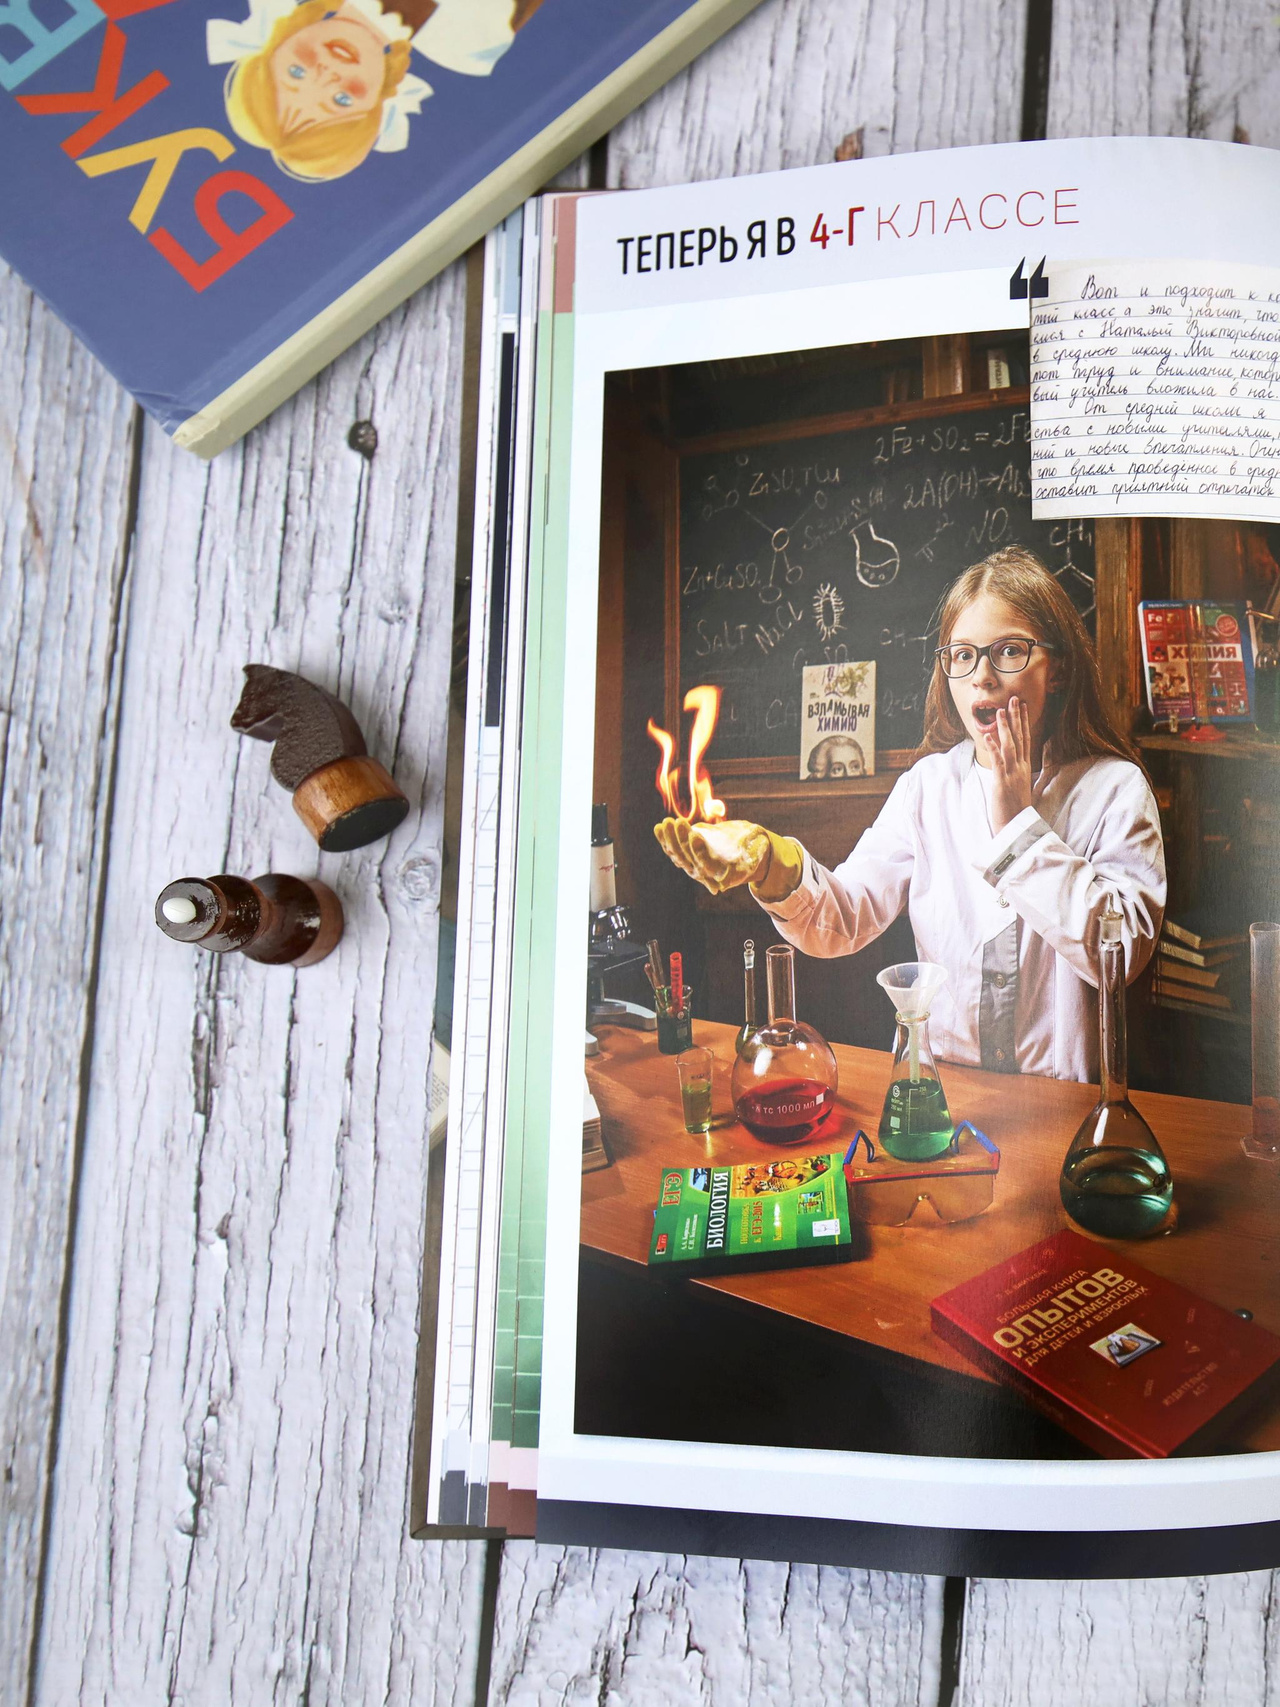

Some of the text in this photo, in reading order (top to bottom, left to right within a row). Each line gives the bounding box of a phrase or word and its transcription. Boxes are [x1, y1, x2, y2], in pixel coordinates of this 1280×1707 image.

[0, 0, 295, 294] БУКВ
[616, 188, 1080, 275] ТЕПЕРЬ Я В 4-Г КЛАССЕ
[1081, 274, 1118, 299] Вот
[1140, 286, 1149, 296] и
[1164, 284, 1236, 308] подходит
[1249, 290, 1259, 300] к
[1124, 307, 1132, 316] а
[1148, 304, 1172, 316] это
[1256, 310, 1279, 323] что
[1078, 329, 1085, 338] с
[1033, 348, 1040, 363] в
[1053, 346, 1118, 370] среднюю
[1184, 338, 1215, 357] Мы
[1073, 365, 1115, 388] труд
[1130, 366, 1141, 376] и
[1070, 383, 1129, 408] учитель
[1147, 378, 1217, 397] вложила
[1230, 381, 1238, 396] в
[1248, 388, 1279, 399] нас.
[1085, 396, 1107, 415] От
[1192, 404, 1242, 417] школы
[1253, 407, 1267, 419] я
[1034, 425, 1071, 439] ства
[1087, 425, 1094, 435] с
[1107, 419, 1167, 435] новыми
[1064, 447, 1076, 456] и
[1088, 440, 1130, 455] новые
[1037, 466, 1057, 480] что
[1071, 458, 1115, 483] время
[1229, 460, 1237, 475] в
[1035, 482, 1098, 499] оставит
[1112, 477, 1189, 504] приятный
[1199, 482, 1275, 496] отпечаток
[808, 698, 870, 718] ВЗЛАМЫВАЯ
[817, 716, 858, 732] ХИМИЮ
[777, 1103, 801, 1115] 1000
[661, 1172, 683, 1208] ЕГЭ
[706, 1170, 729, 1250] БИОЛОГИЯ
[993, 1267, 1125, 1349] ОПЫТОВ
[996, 1268, 1089, 1324] БОЛЬШАЯ КНИГА
[1011, 1278, 1138, 1359] И ЭКСПЕРИМЕНТОВ
[1024, 1285, 1149, 1368] ДЛЯ ДЕТЕЙ И ВЗРОСЛЫХ
